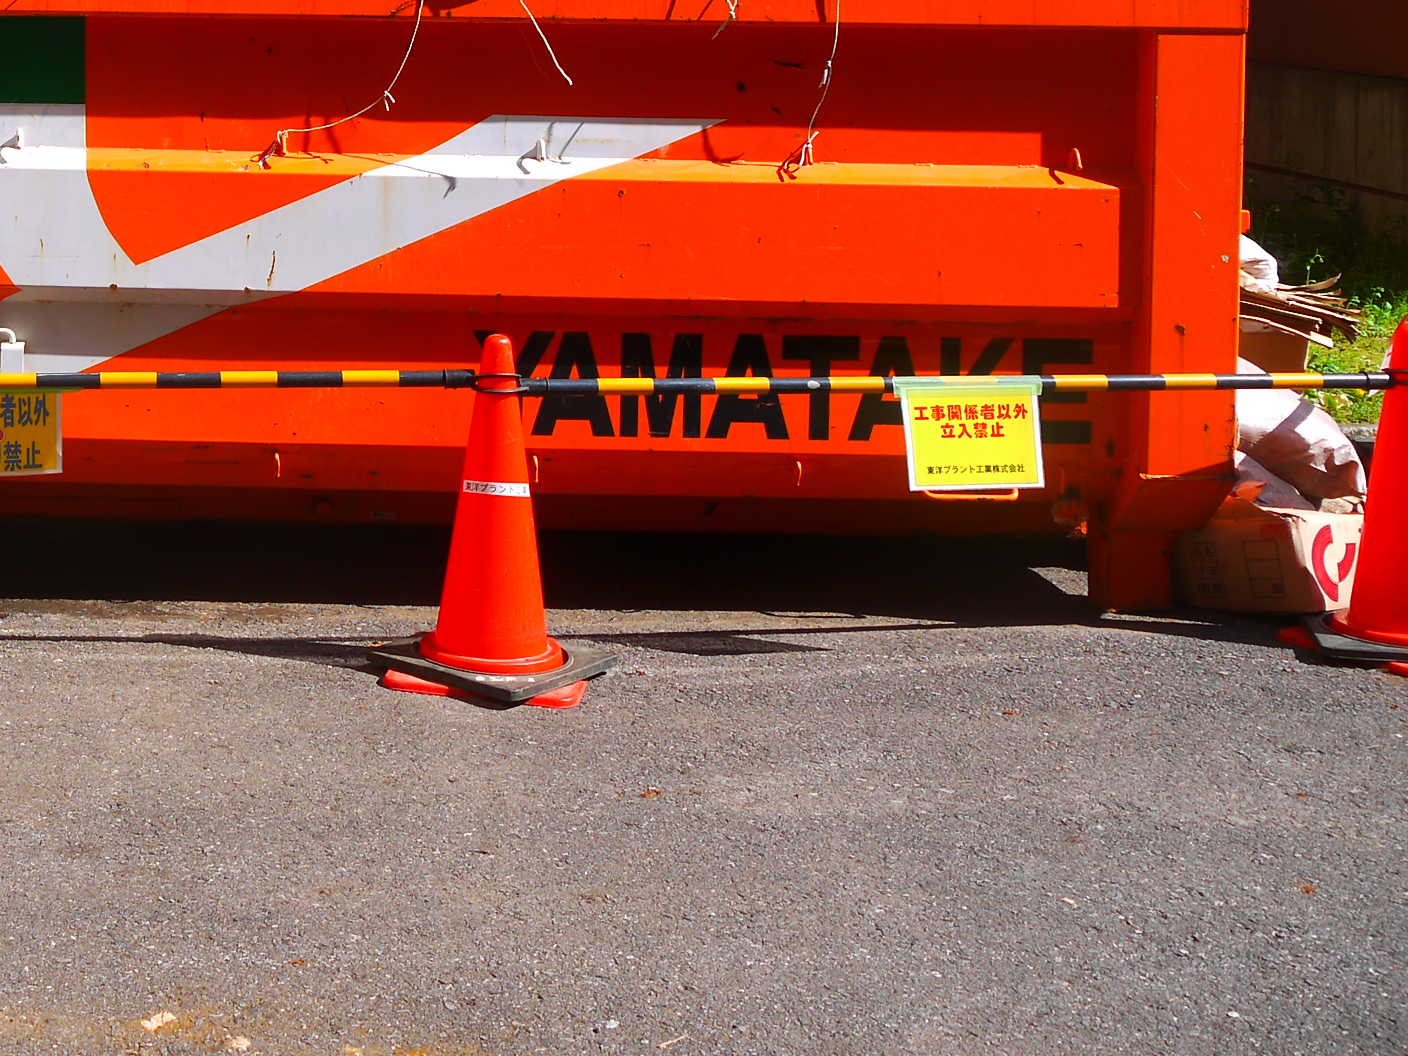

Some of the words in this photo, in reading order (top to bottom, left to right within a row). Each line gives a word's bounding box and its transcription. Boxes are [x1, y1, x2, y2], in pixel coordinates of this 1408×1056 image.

[914, 403, 1029, 422] 工事関係者以外
[940, 422, 1006, 439] 立入禁止
[926, 463, 1026, 476] 東洋プラント工業株式会社
